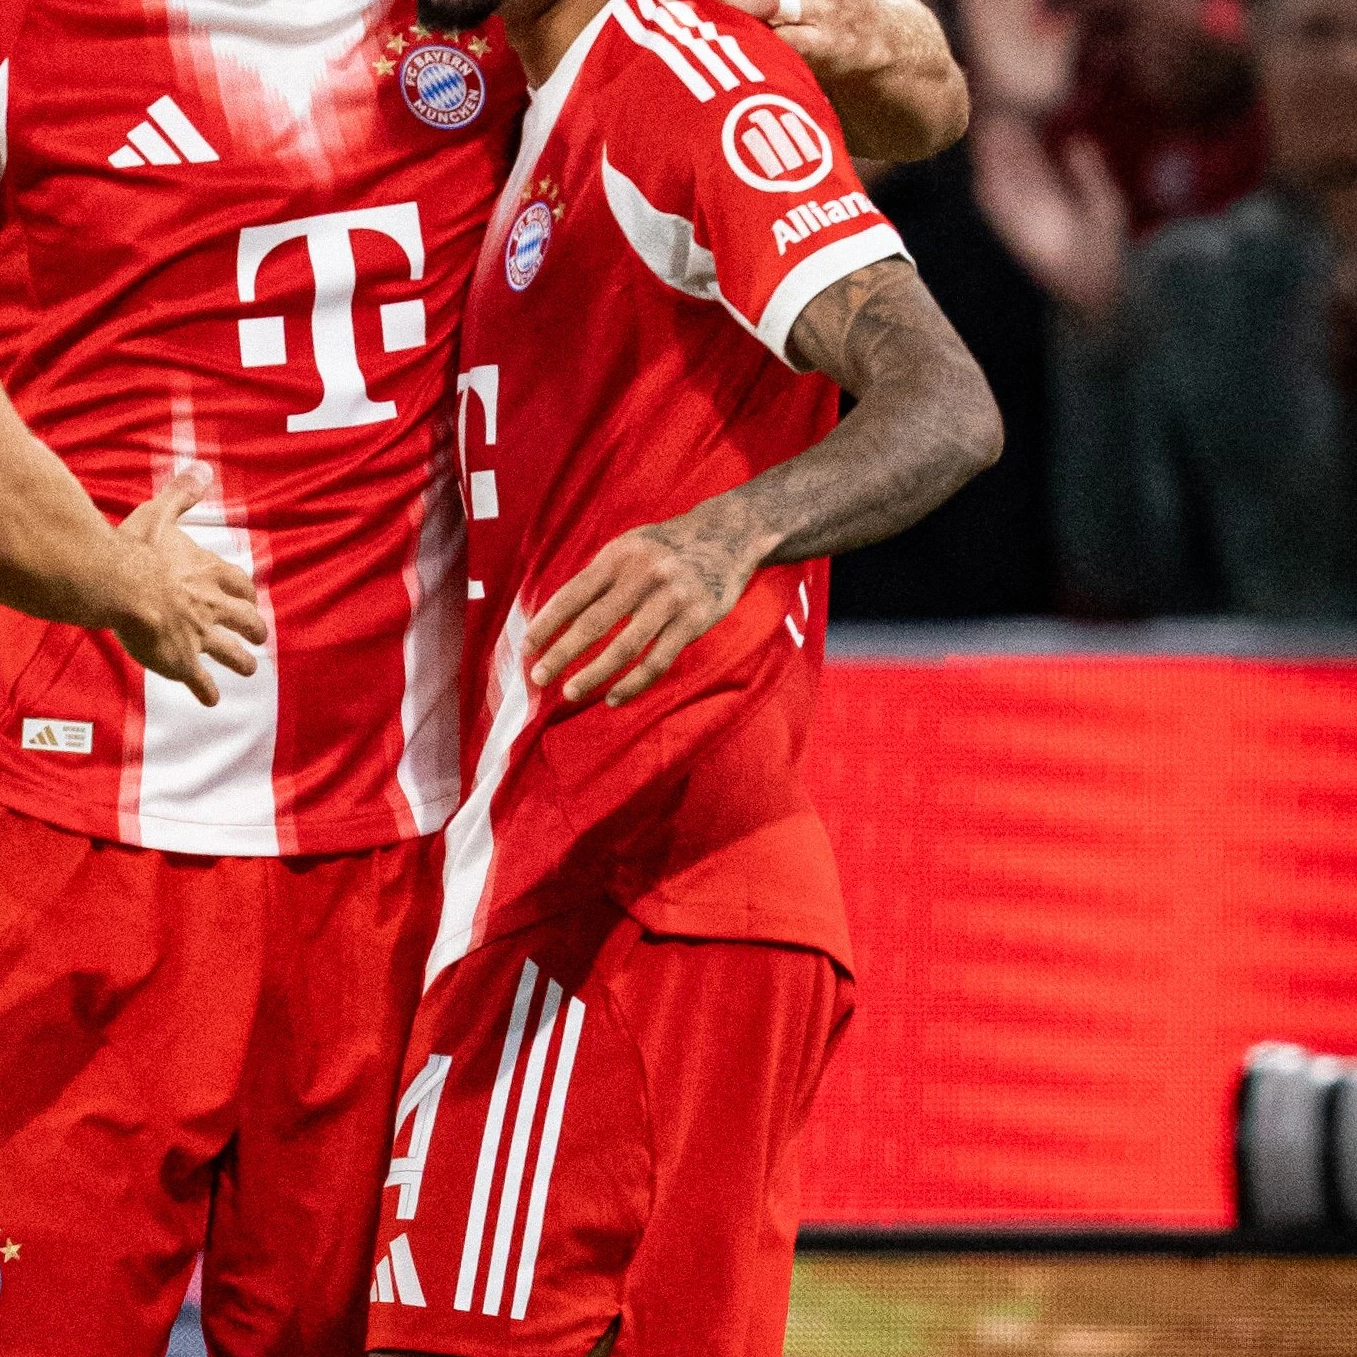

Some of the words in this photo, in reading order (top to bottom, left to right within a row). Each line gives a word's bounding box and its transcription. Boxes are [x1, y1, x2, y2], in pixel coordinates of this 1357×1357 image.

[405, 66, 418, 86] FC
[413, 51, 473, 76] BAYERN
[772, 191, 881, 257] Allian
[236, 201, 427, 433] T
